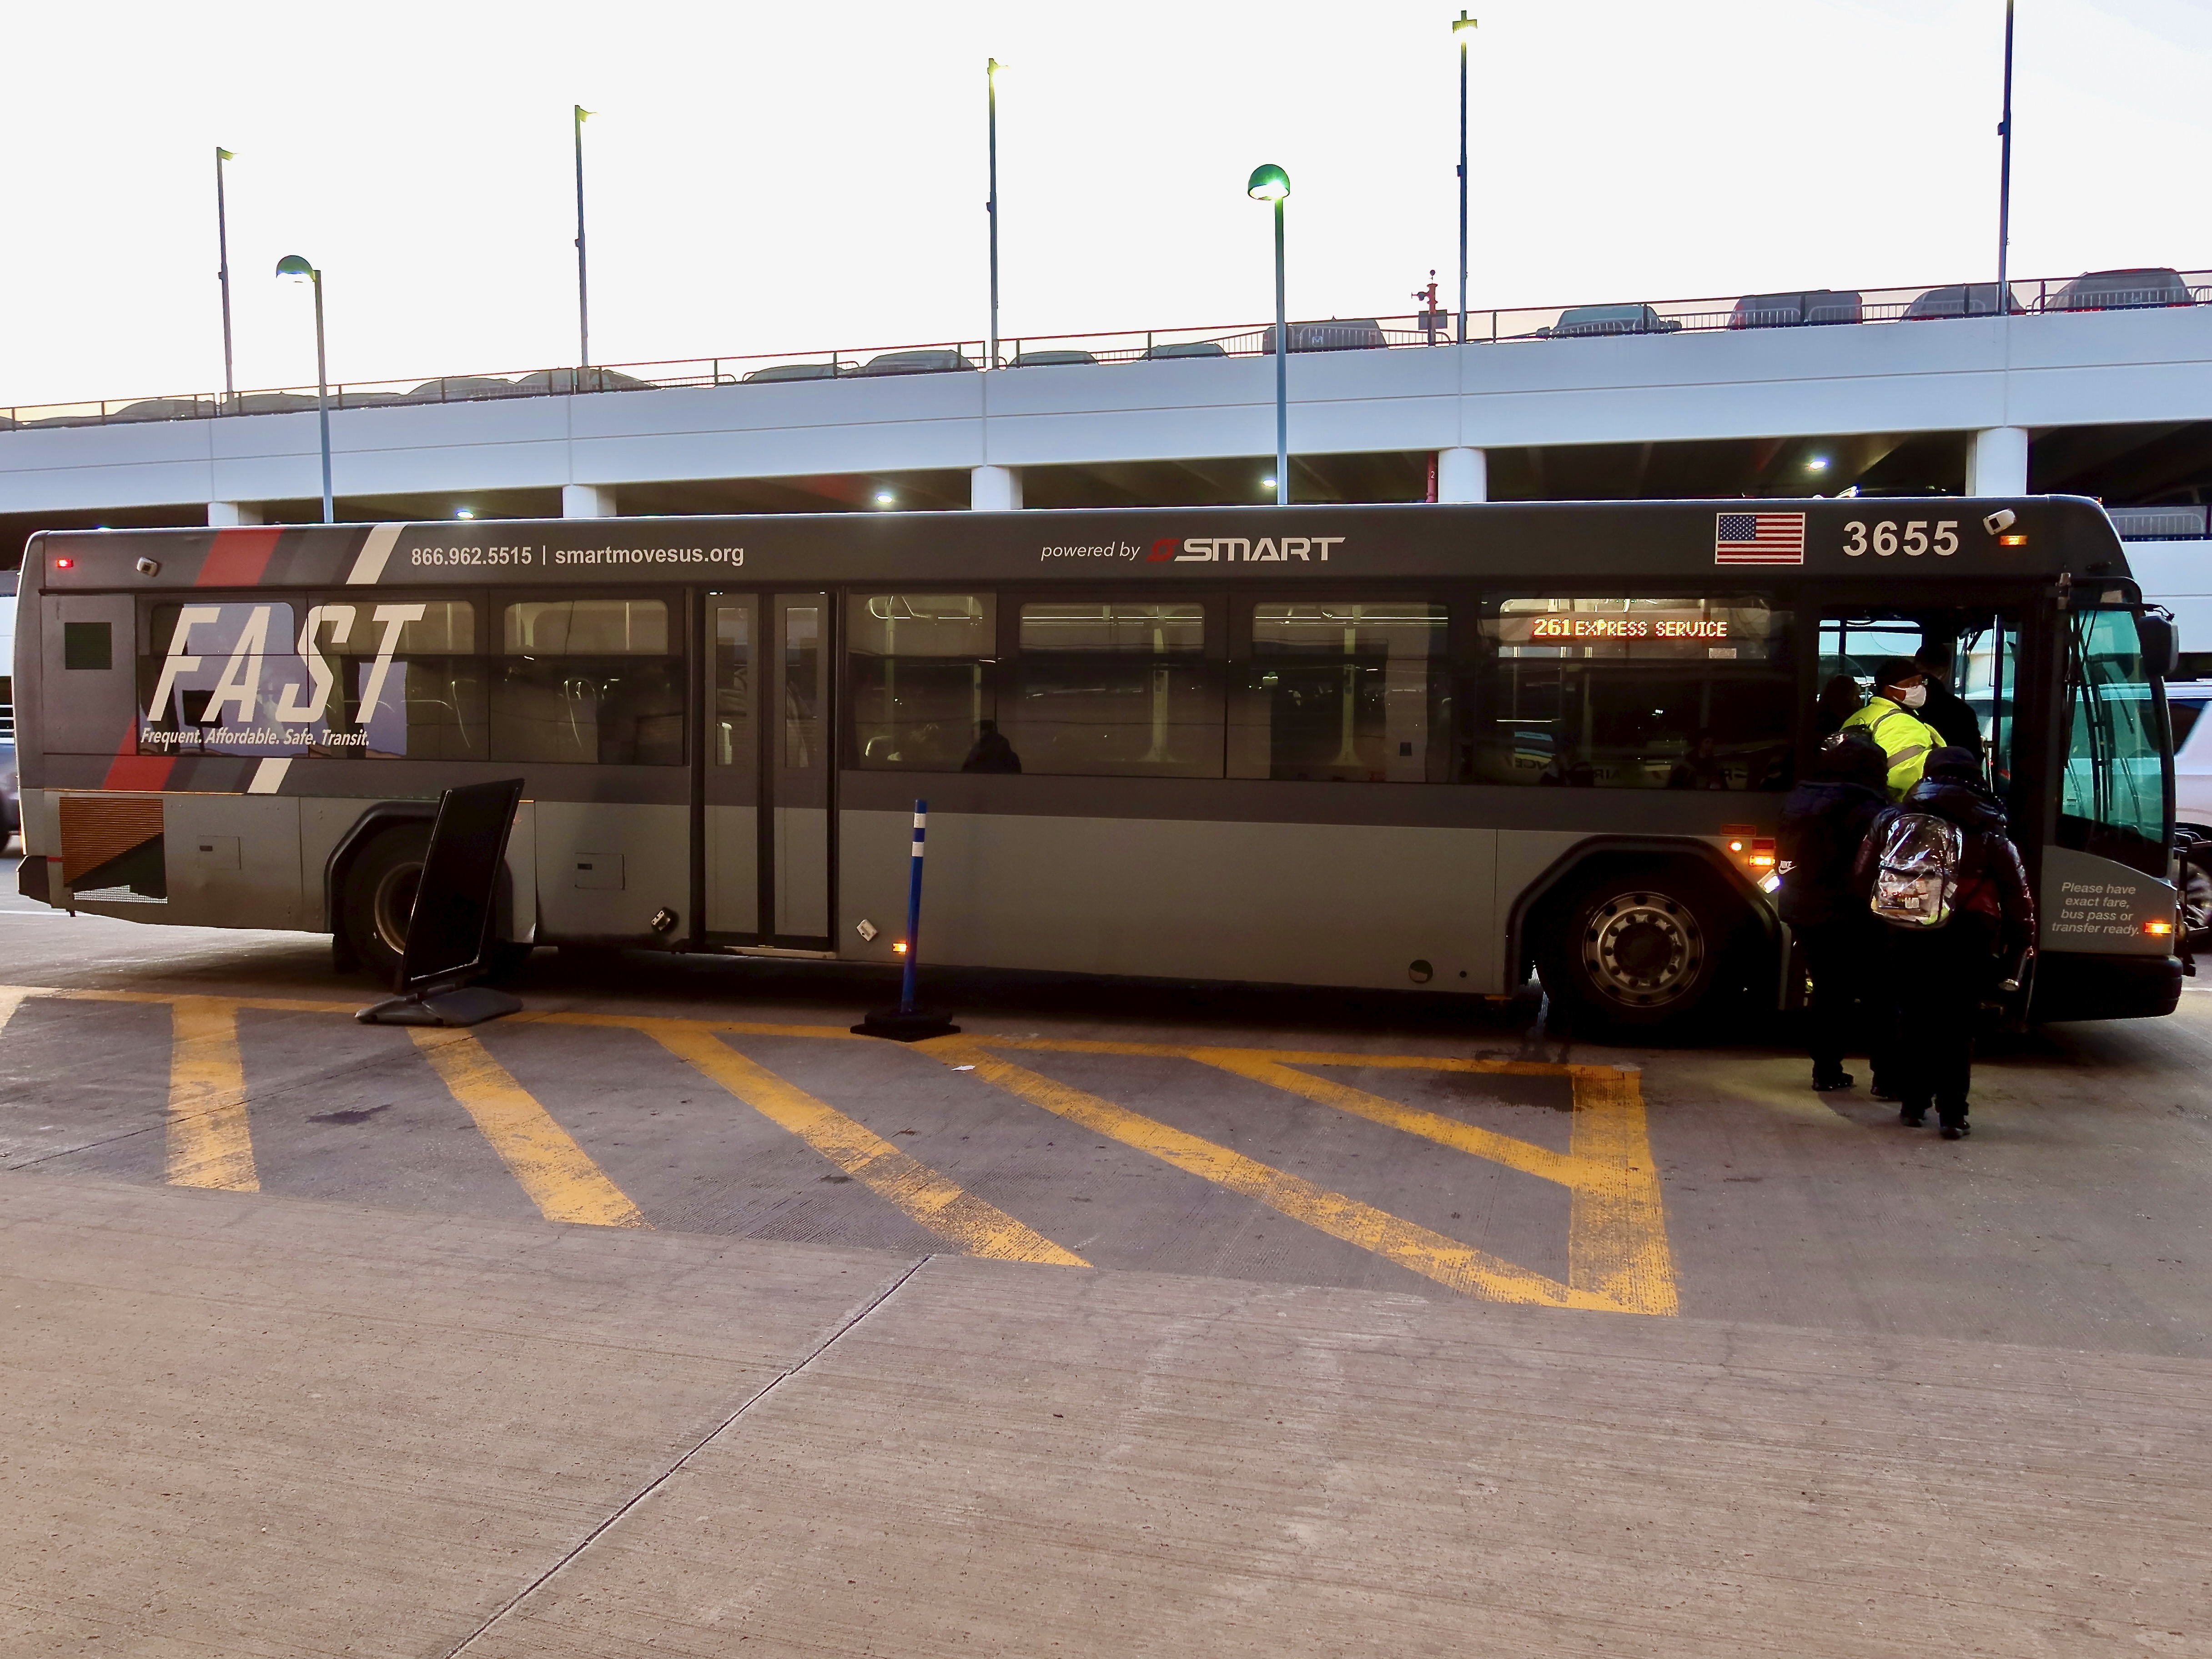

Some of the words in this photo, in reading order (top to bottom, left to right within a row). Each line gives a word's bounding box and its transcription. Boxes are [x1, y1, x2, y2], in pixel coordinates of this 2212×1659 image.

[1430, 471, 1435, 479] 2
[1843, 521, 1959, 557] 3655
[411, 547, 532, 566] 866.962.5515
[555, 546, 744, 567] smartmovesus.org
[1041, 541, 1115, 561] powered
[1119, 541, 1141, 561] by
[1174, 537, 1346, 562] SMART
[1533, 618, 1571, 637] 261
[1574, 619, 1648, 637] EXPRESS
[1655, 621, 1728, 637] SERVICE
[146, 603, 427, 723] FAST
[140, 727, 202, 752] Frequent.
[204, 727, 280, 745] Affordable.
[283, 728, 316, 745] Safe.
[322, 729, 370, 746] Transit.
[2061, 882, 2103, 893] Please
[2106, 884, 2136, 894] have
[2065, 897, 2099, 906] exact
[2102, 897, 2130, 909] fare,
[2061, 909, 2084, 919] bus
[2086, 912, 2116, 921] pass
[2052, 922, 2101, 932] transfer
[2103, 925, 2139, 936] ready.
